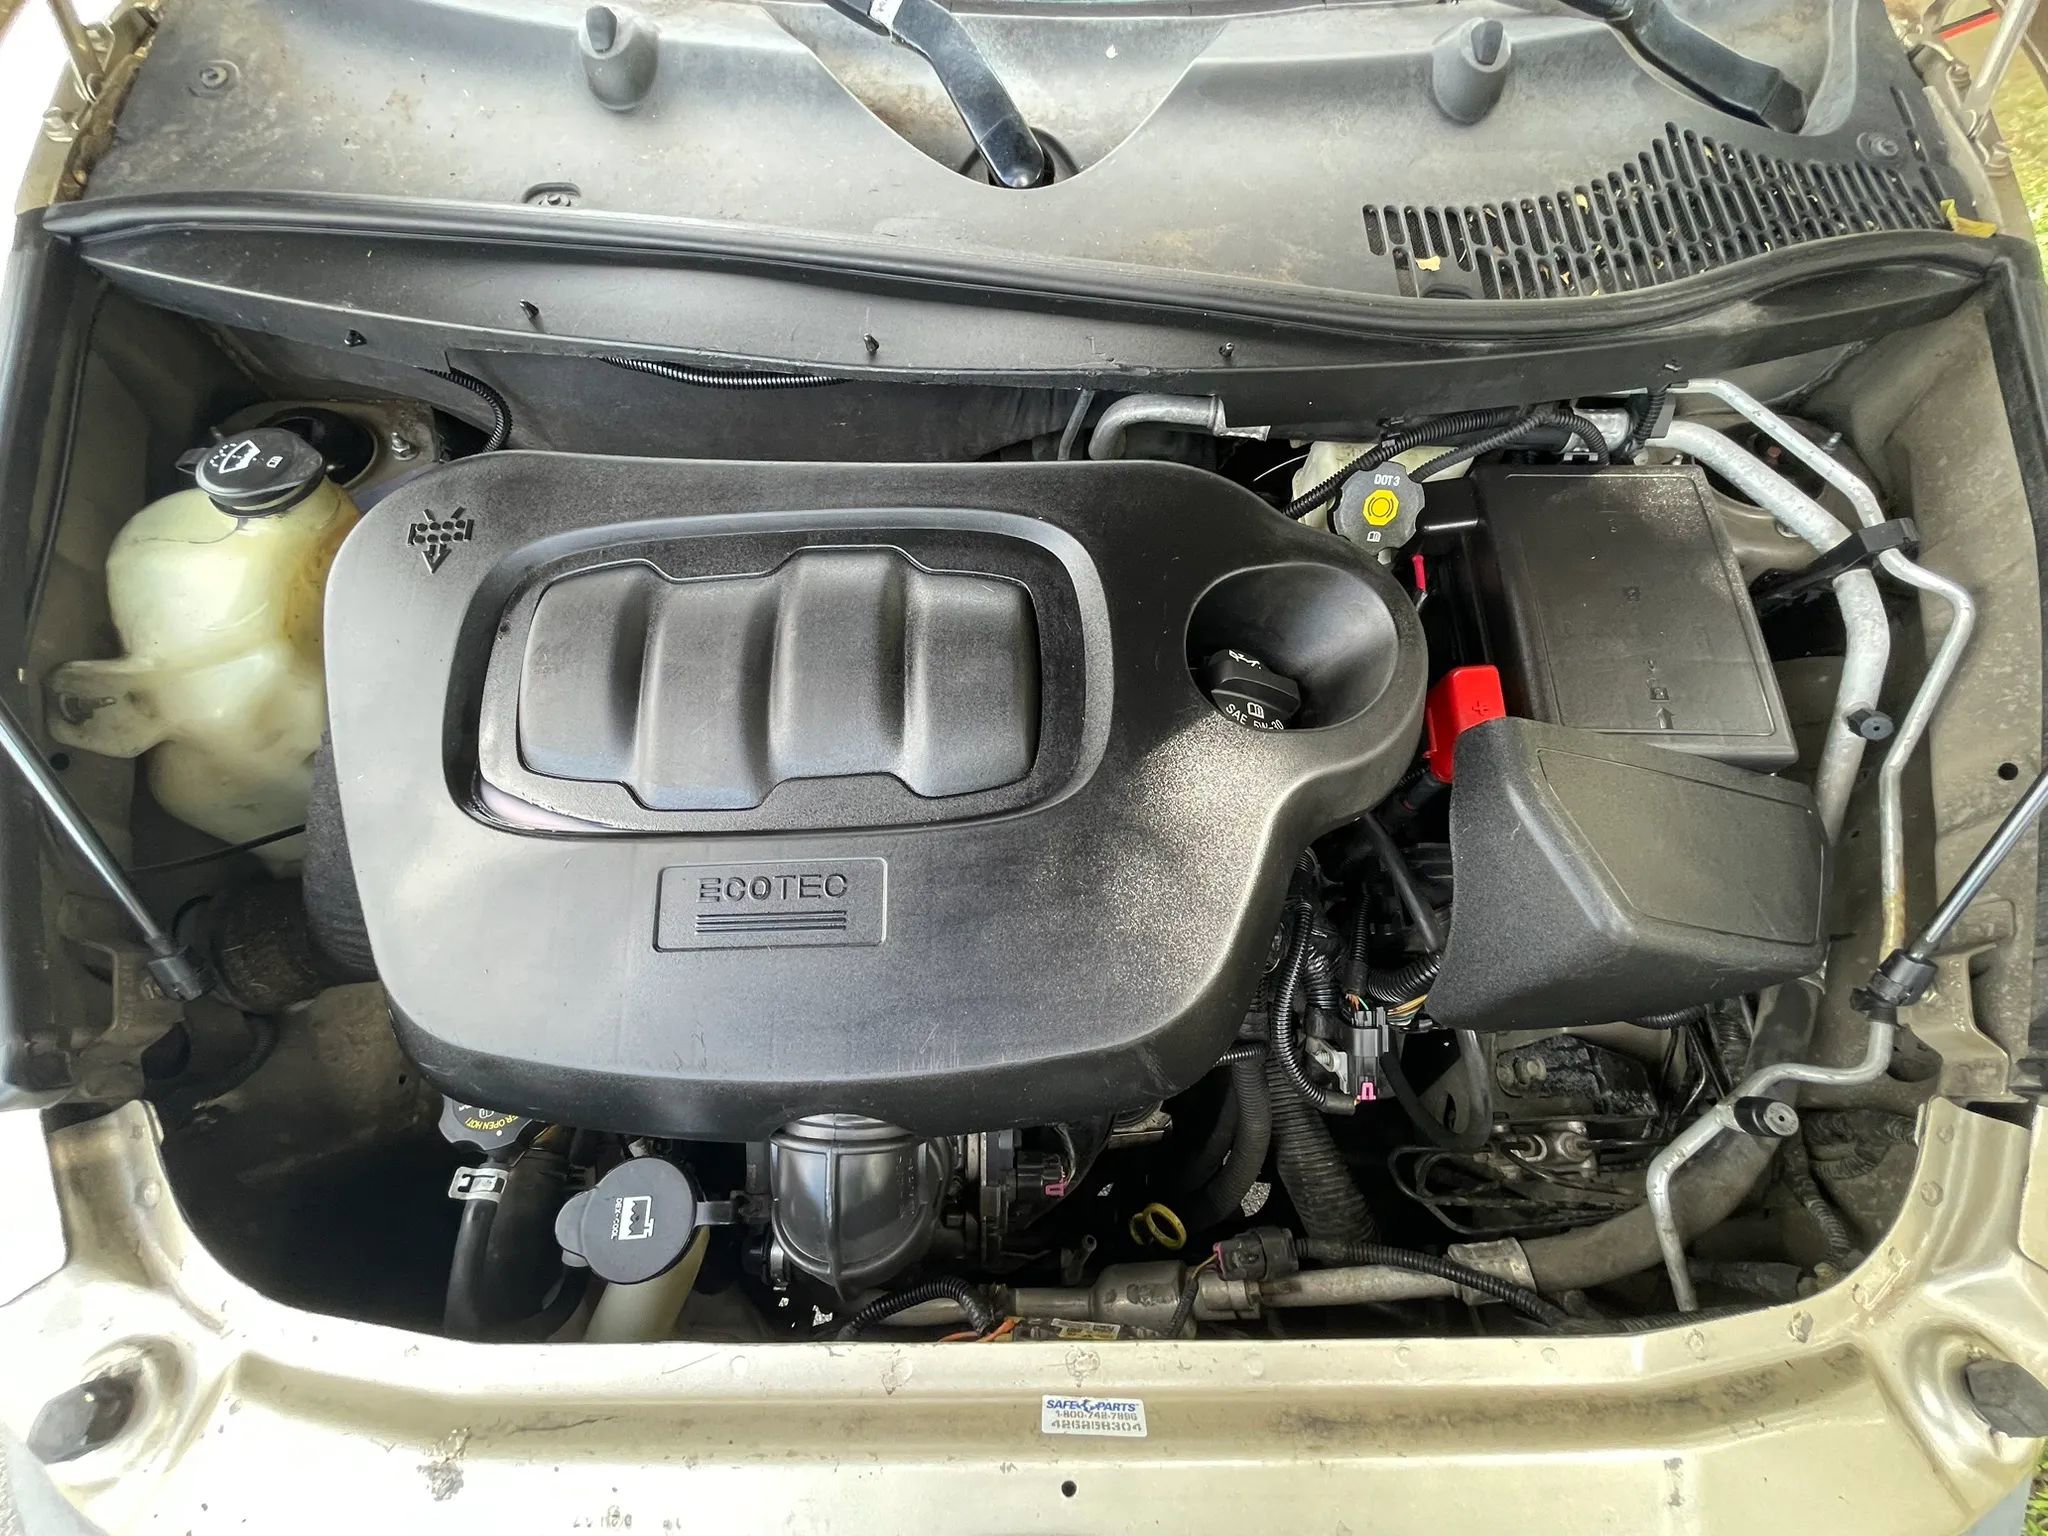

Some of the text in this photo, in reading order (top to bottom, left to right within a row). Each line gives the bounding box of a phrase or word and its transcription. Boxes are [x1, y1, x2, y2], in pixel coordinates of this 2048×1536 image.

[1374, 474, 1393, 486] DOT
[1225, 703, 1248, 725] SAE
[697, 873, 848, 902] ECOTEC
[482, 1118, 505, 1130] OPEN
[1046, 1400, 1136, 1412] SAFE PARTS
